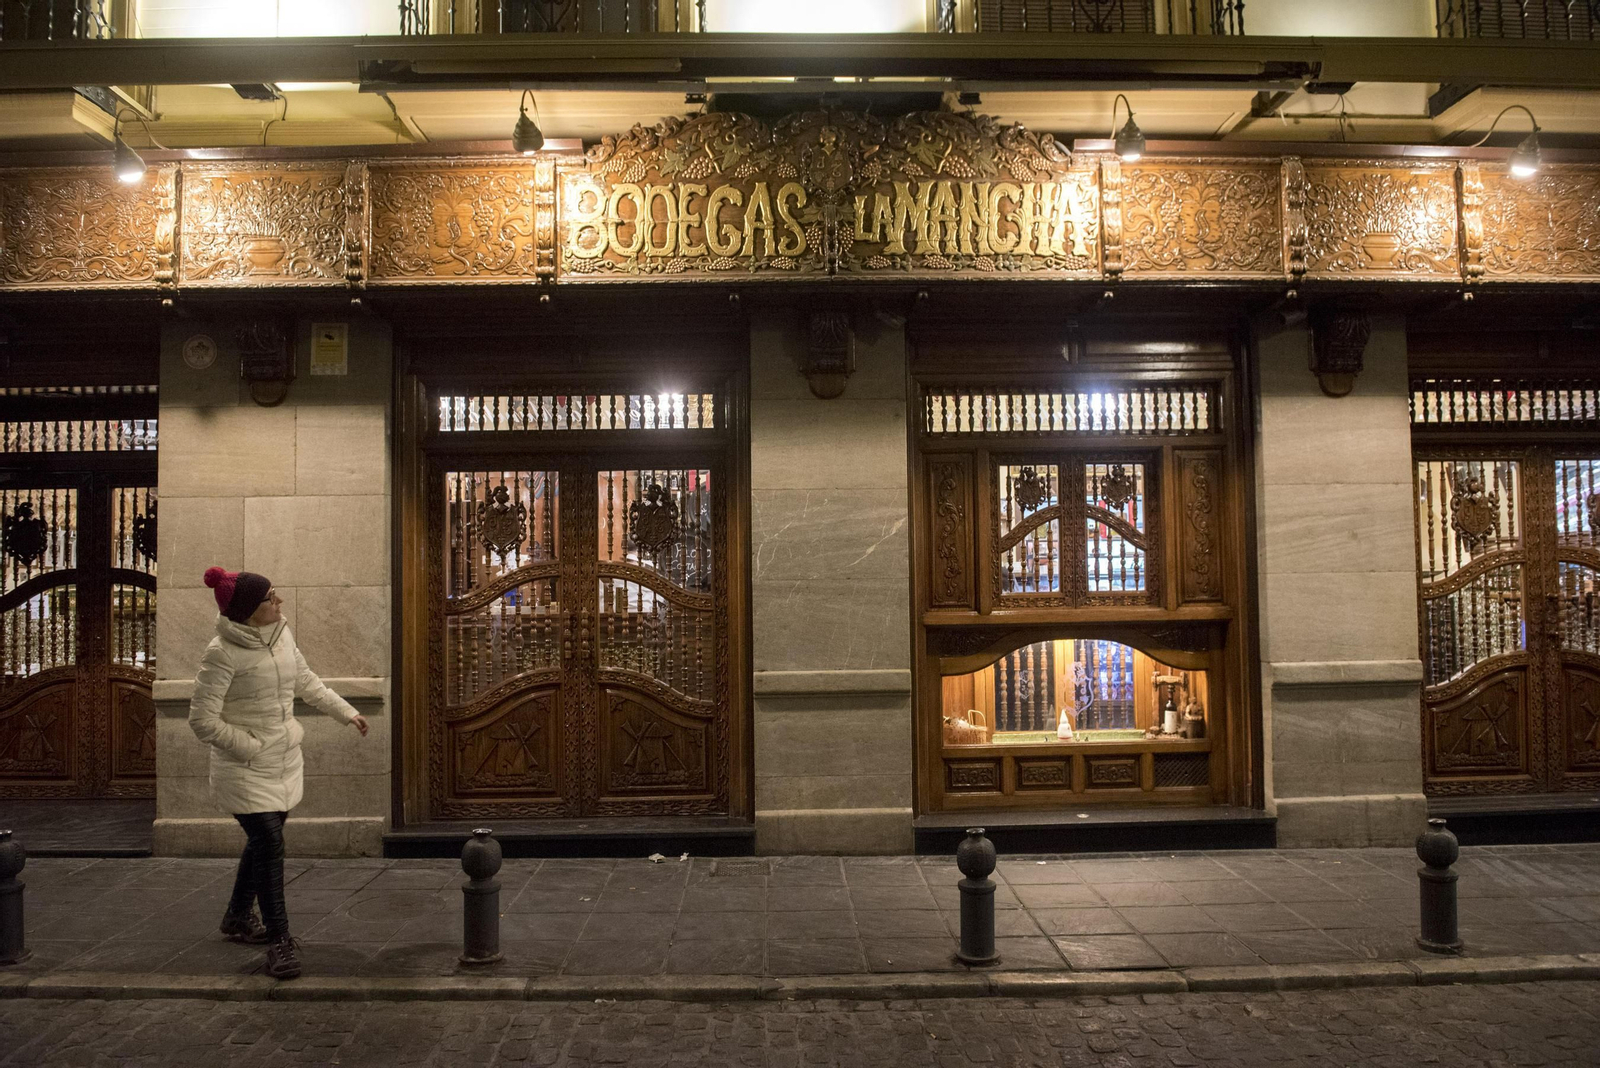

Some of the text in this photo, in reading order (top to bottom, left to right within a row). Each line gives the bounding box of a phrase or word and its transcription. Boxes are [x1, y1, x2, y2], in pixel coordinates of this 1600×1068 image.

[567, 180, 1090, 258] BODEGAS LA MANCHA
